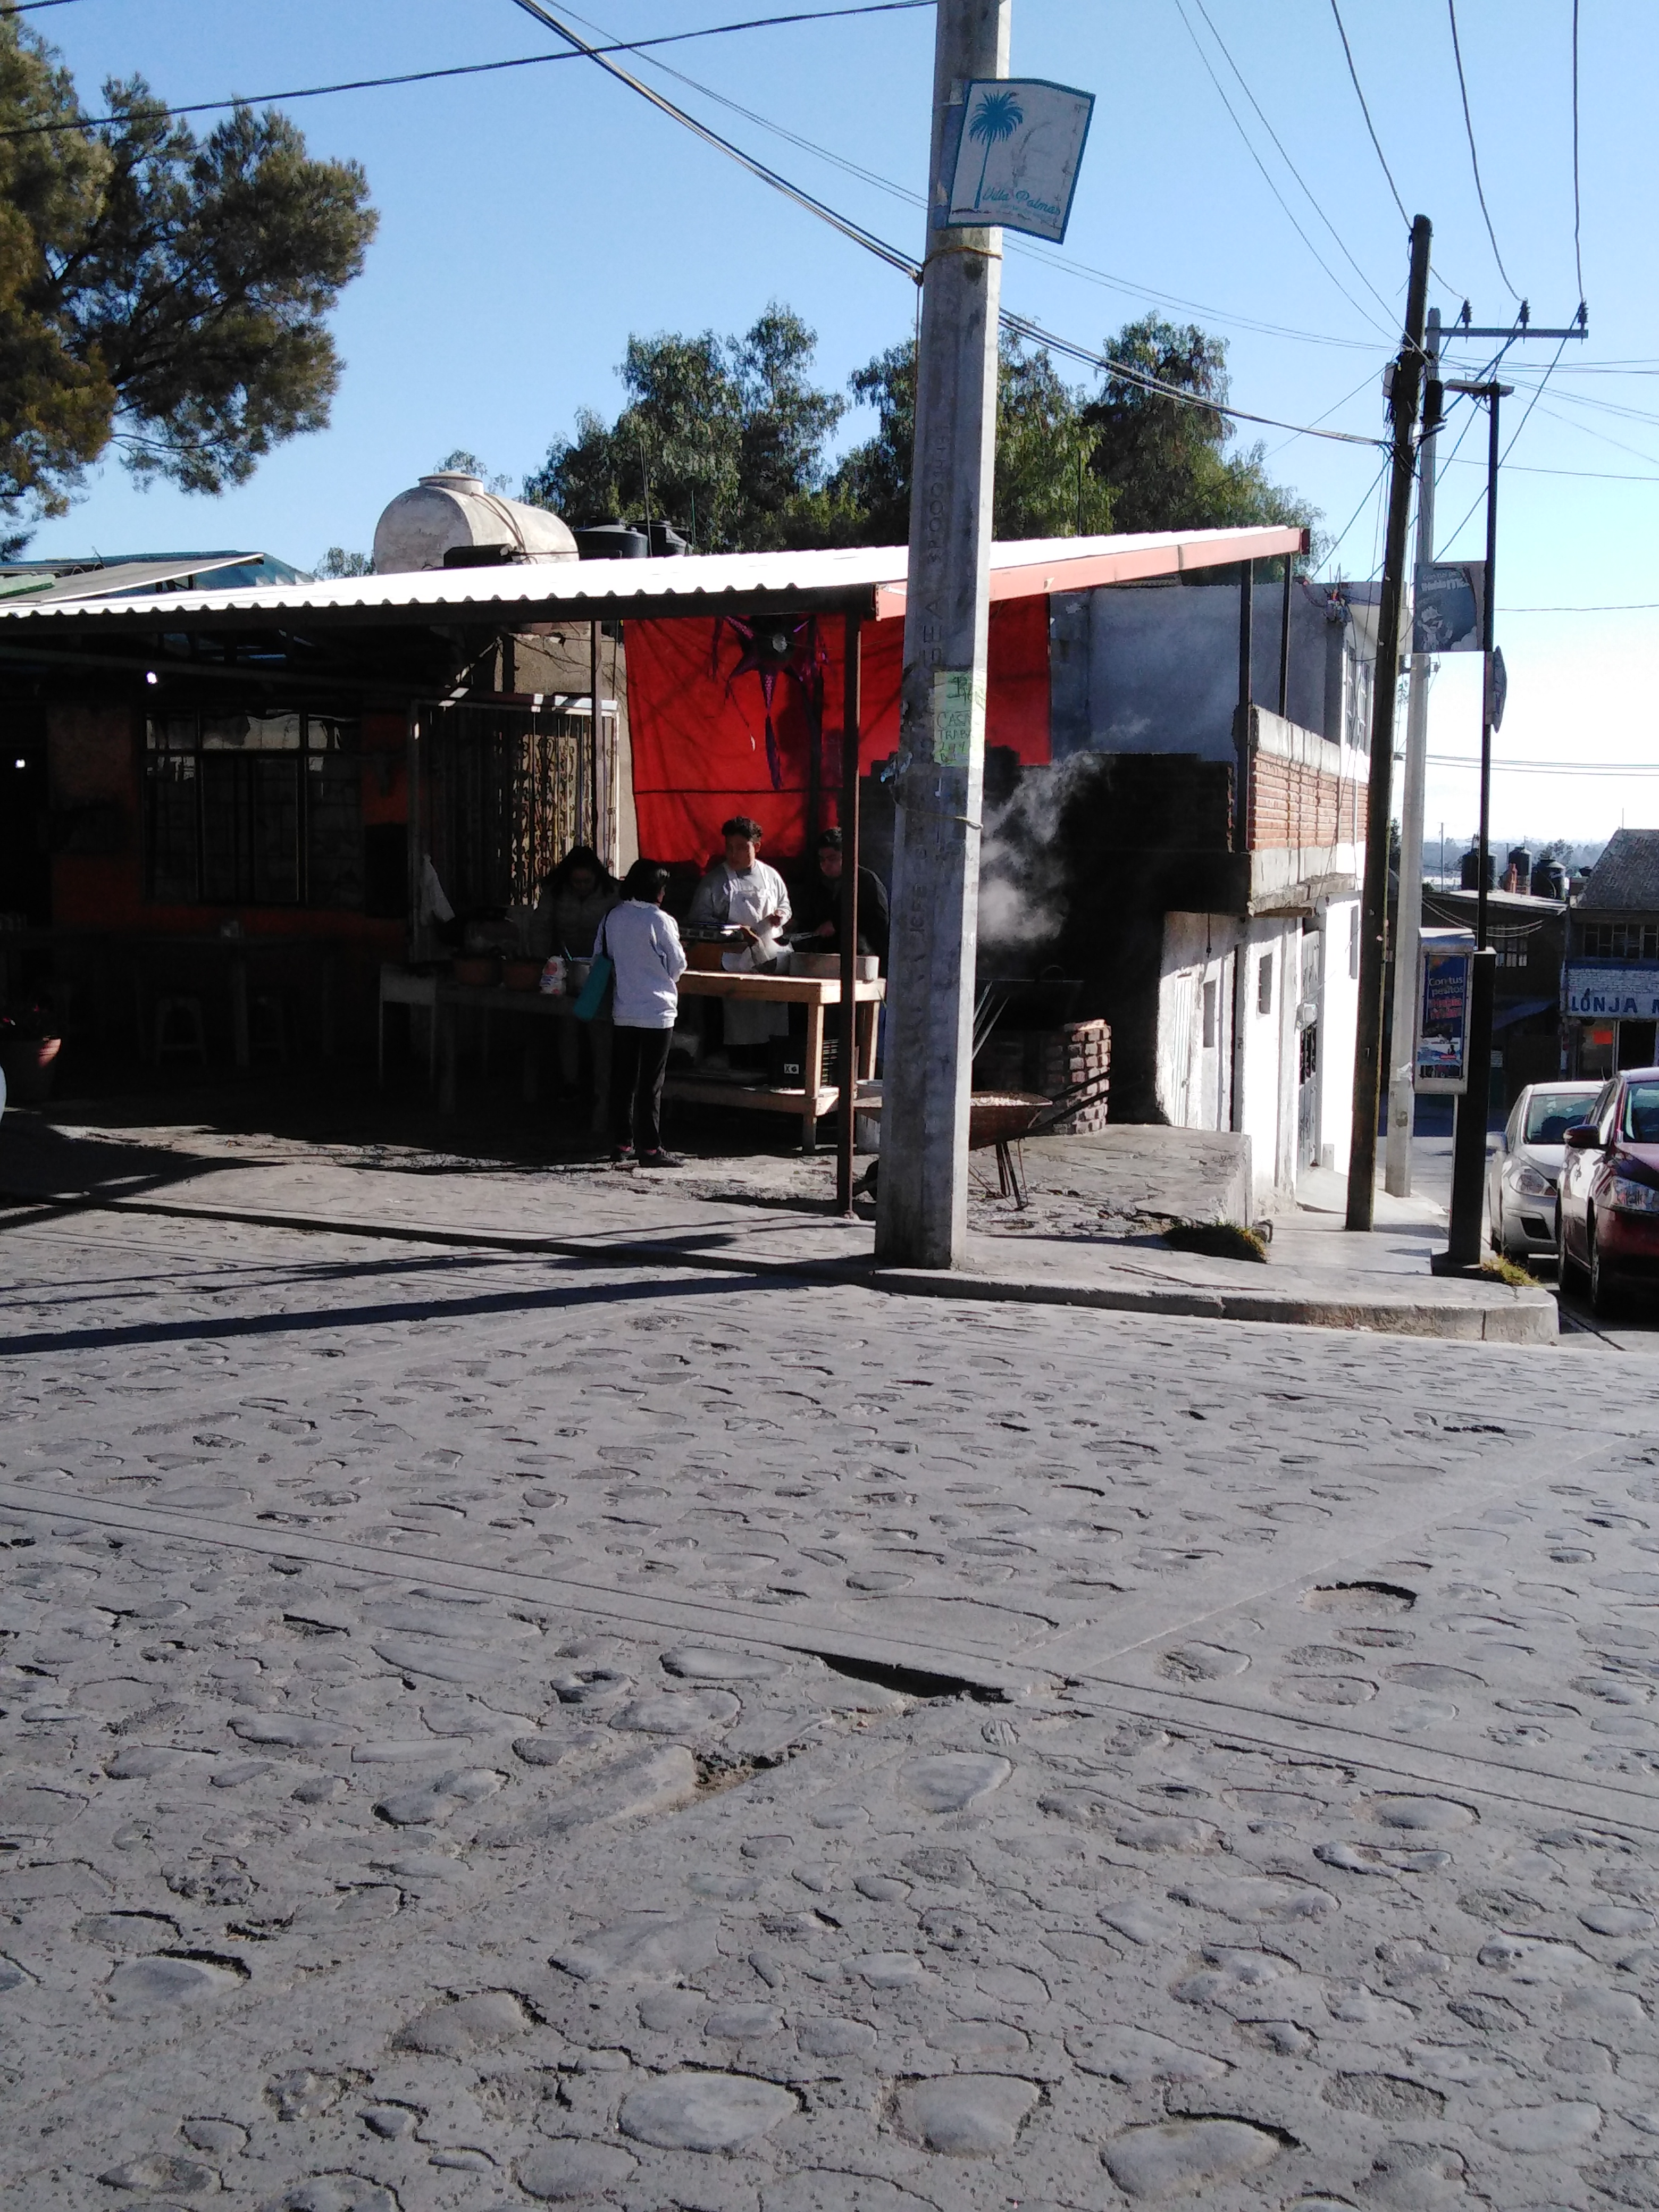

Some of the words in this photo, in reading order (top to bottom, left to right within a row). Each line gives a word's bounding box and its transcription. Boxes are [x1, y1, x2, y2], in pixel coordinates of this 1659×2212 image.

[983, 187, 1010, 201] Villa
[1429, 978, 1447, 986] Con
[1448, 976, 1463, 985] tus
